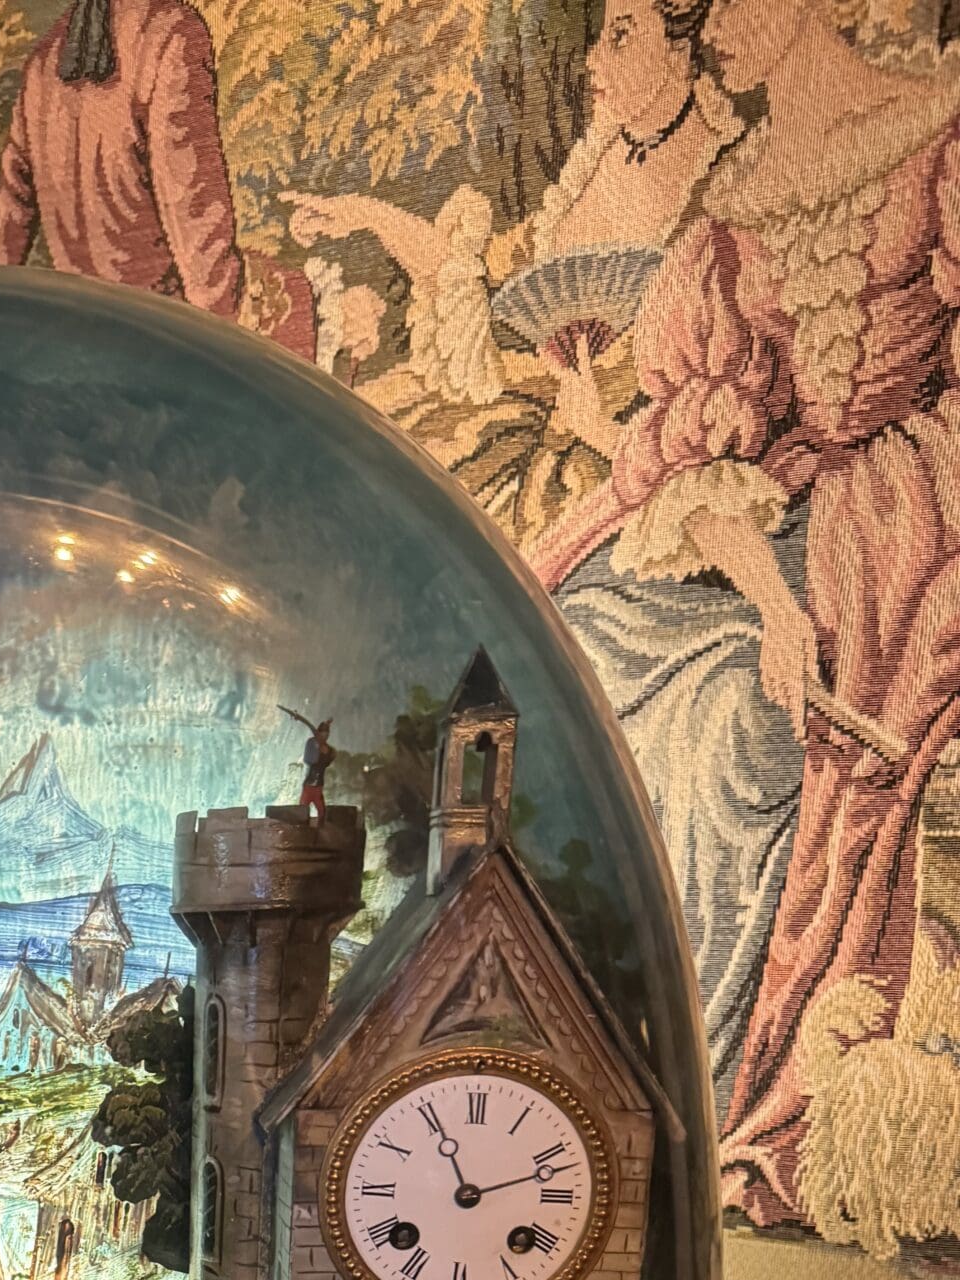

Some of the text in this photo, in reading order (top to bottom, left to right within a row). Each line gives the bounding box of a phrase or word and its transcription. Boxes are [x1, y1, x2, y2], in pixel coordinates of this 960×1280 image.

[464, 1092, 489, 1125] XII
[508, 1106, 533, 1136] I
[377, 1134, 413, 1163] X
[532, 1142, 566, 1165] II
[361, 1180, 397, 1200] IX
[540, 1188, 574, 1206] III
